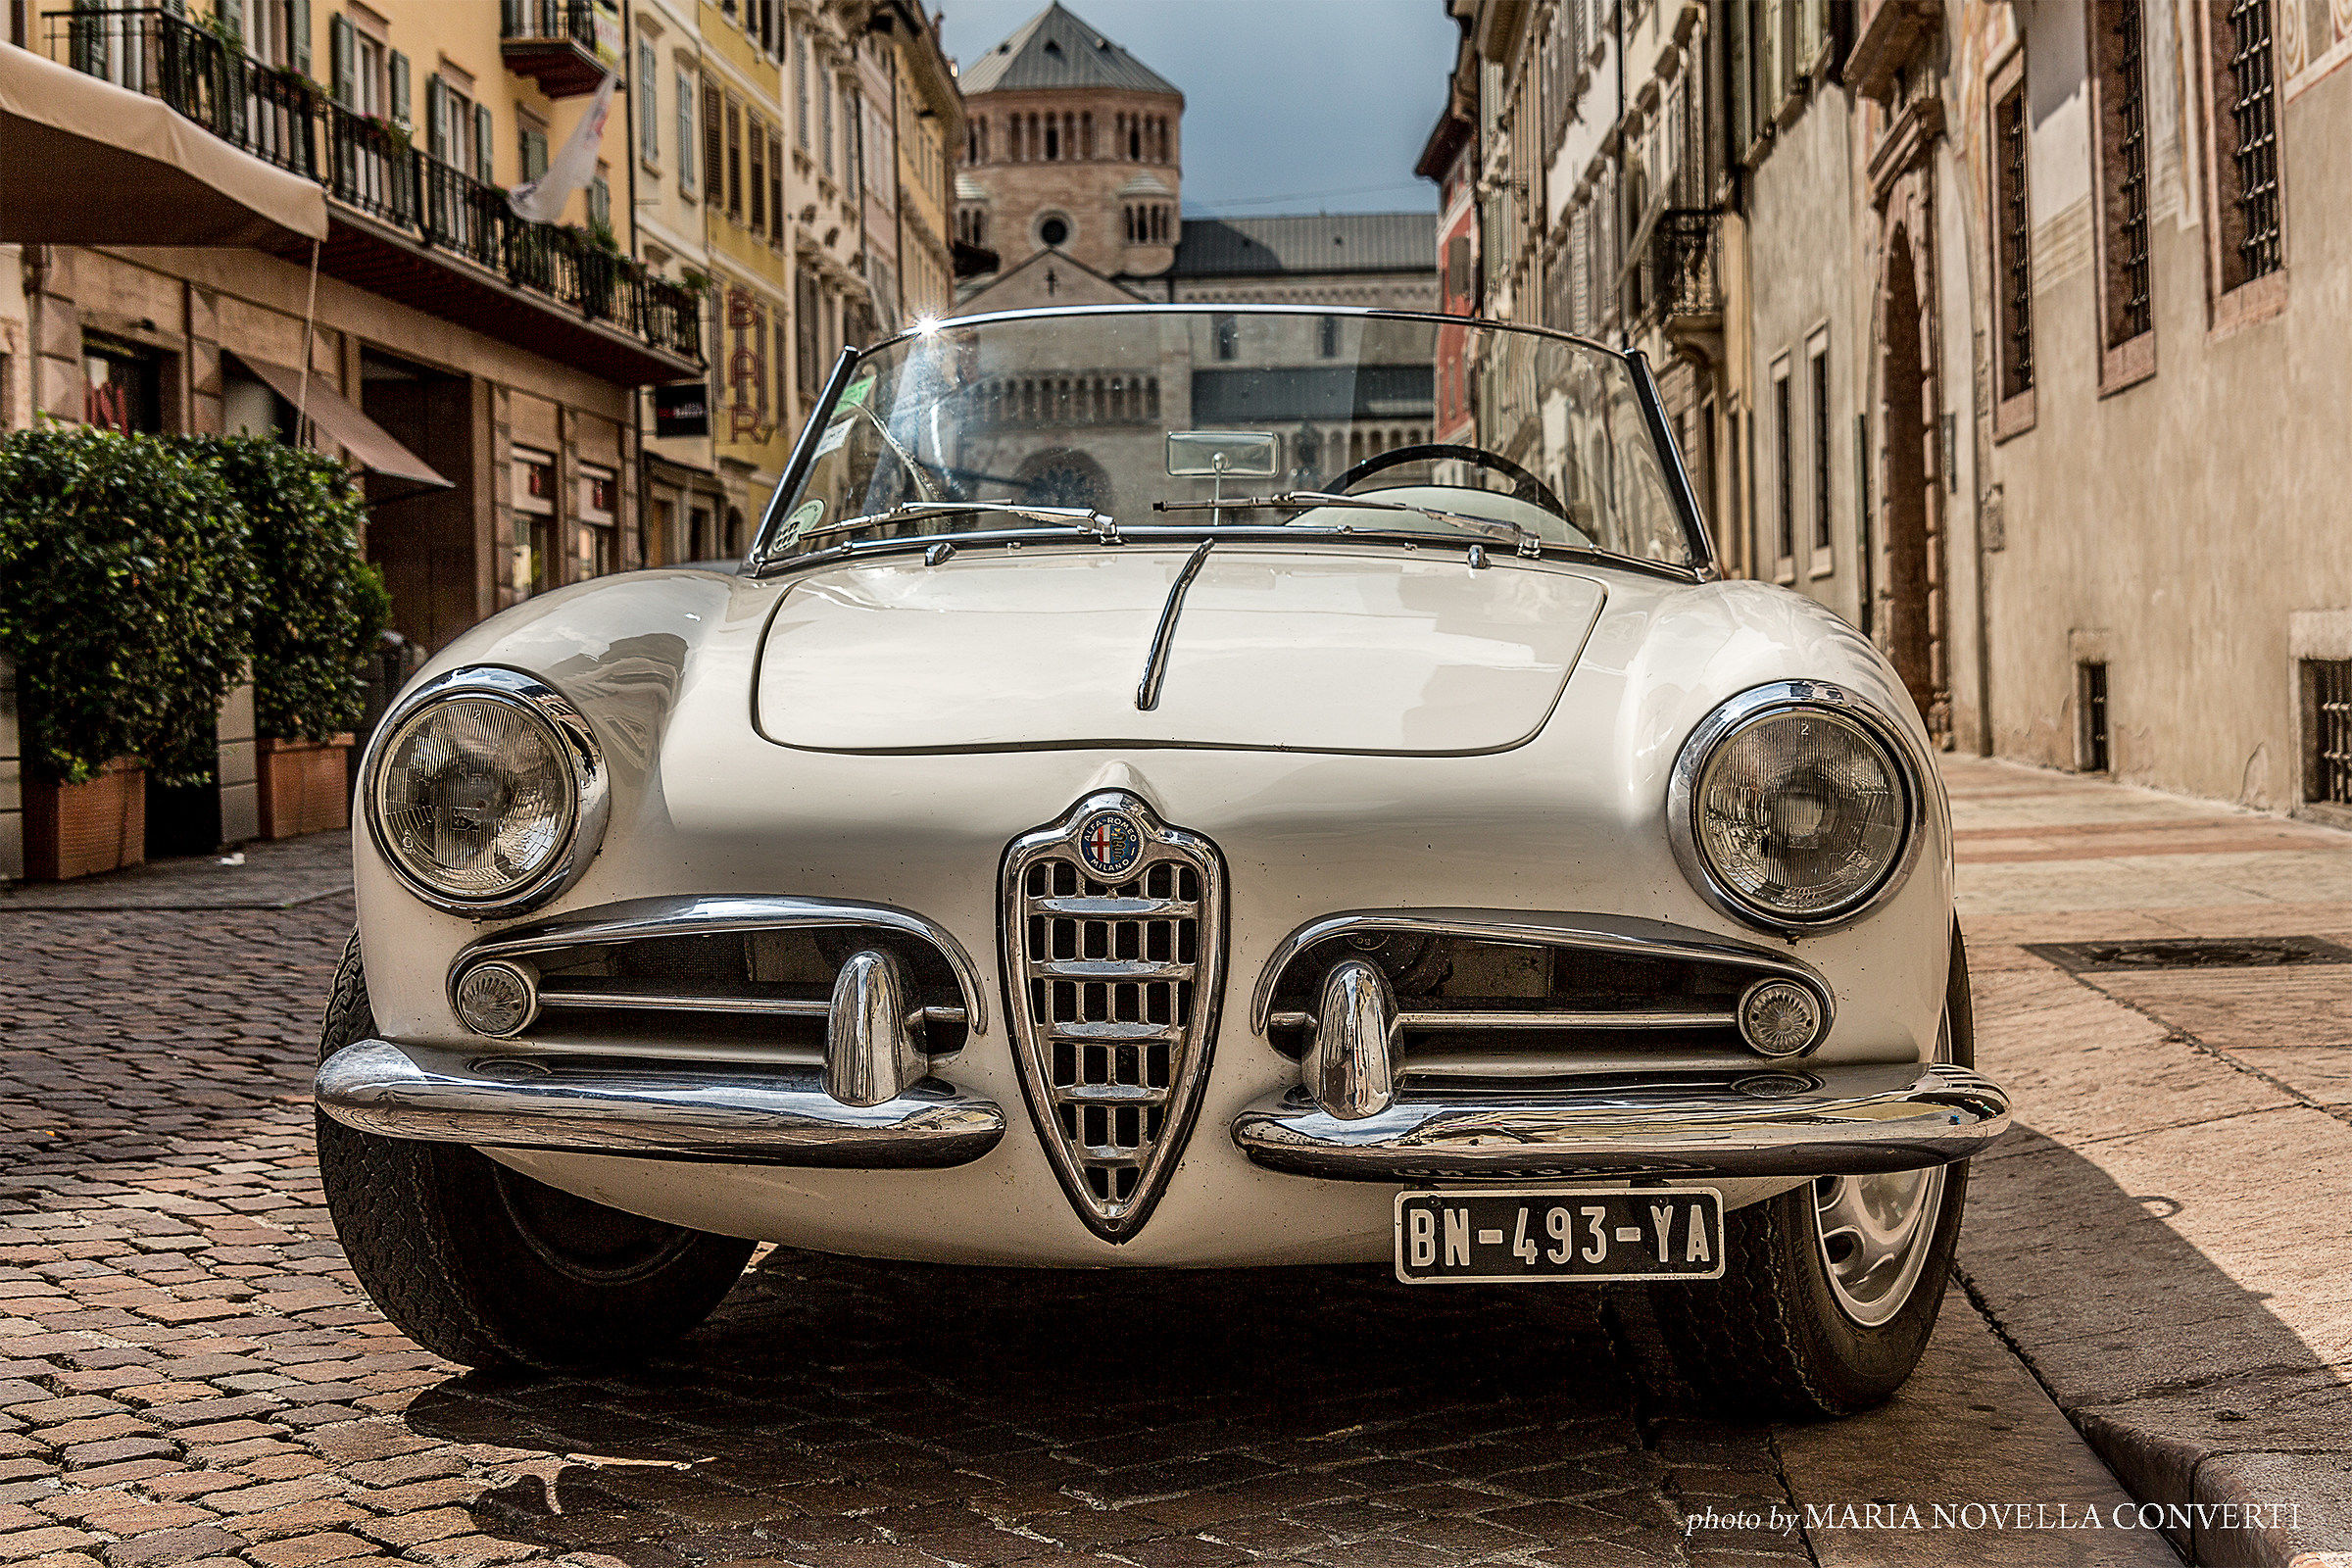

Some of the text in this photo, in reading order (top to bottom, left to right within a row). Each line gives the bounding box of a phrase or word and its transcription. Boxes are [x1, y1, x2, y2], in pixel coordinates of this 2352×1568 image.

[729, 290, 763, 444] BAR
[1090, 858, 1130, 871] MILANO
[1409, 1205, 1711, 1267] BN-493-YA
